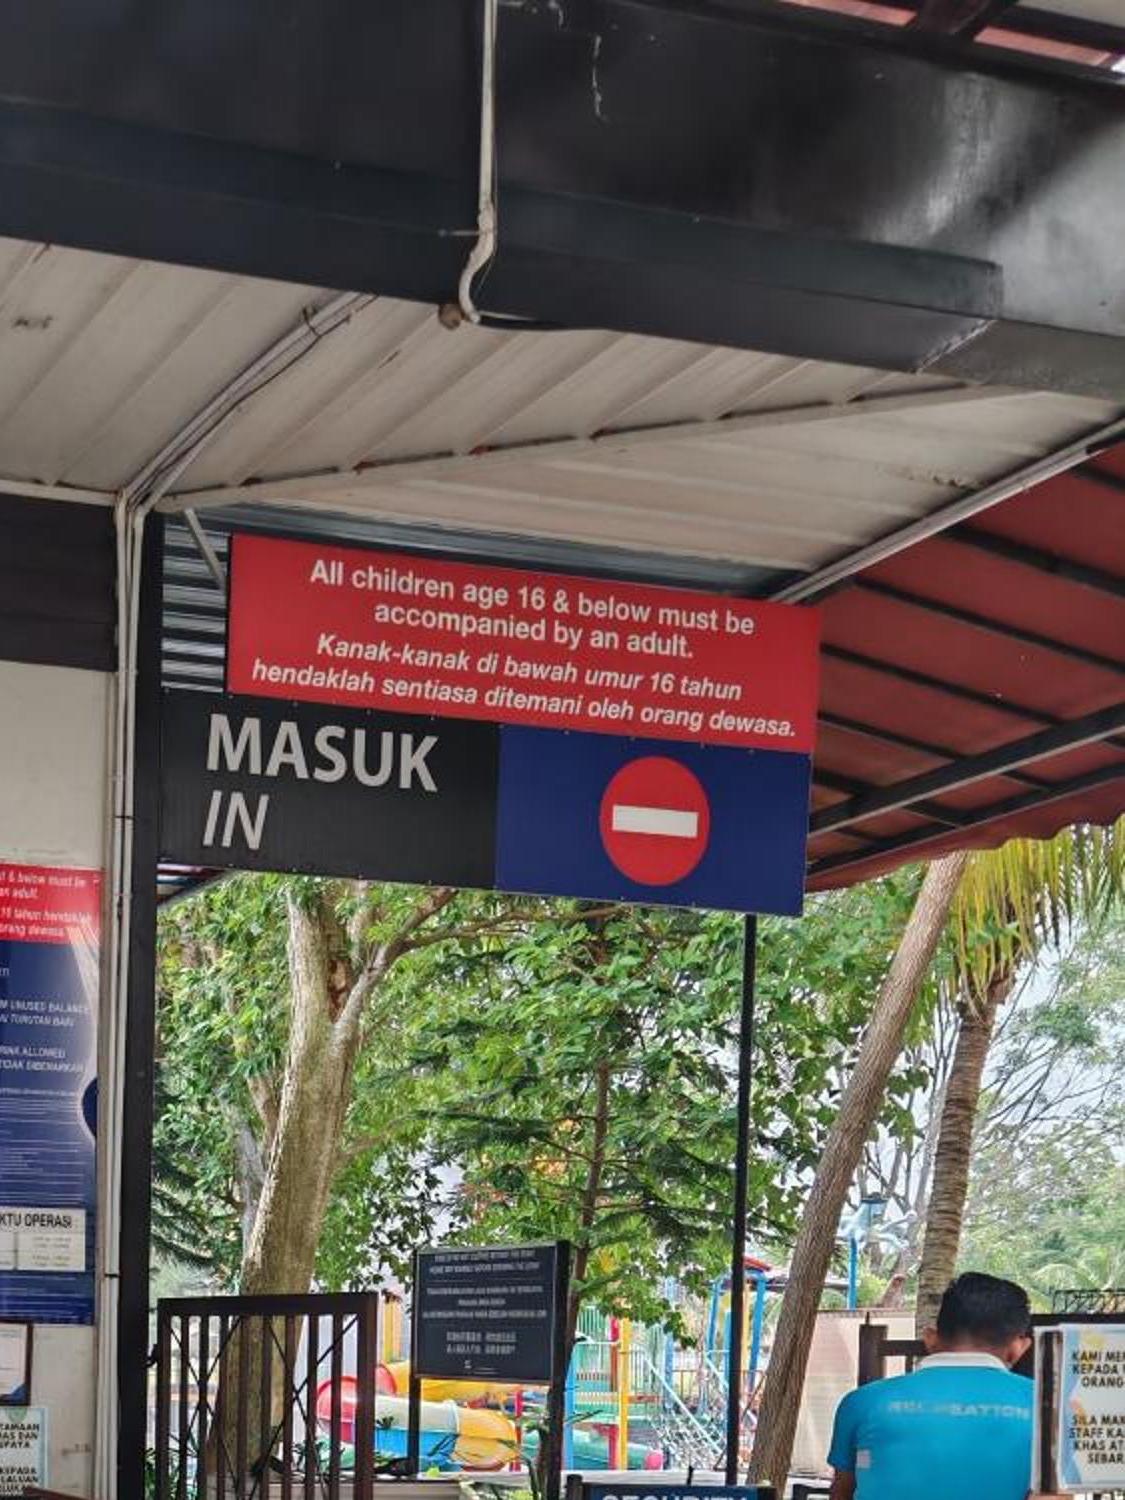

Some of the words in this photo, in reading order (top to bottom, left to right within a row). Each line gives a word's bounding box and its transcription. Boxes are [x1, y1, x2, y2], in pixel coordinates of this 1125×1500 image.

[310, 559, 344, 586] All
[352, 566, 454, 599] children
[463, 583, 508, 610] age
[519, 586, 545, 610] 16
[554, 590, 570, 613] &
[579, 592, 651, 623] below
[658, 606, 718, 631] must
[726, 610, 755, 635] be
[375, 602, 546, 641] accompanied
[554, 619, 581, 649] by
[590, 630, 619, 649] an
[627, 633, 693, 658] adult.
[317, 633, 469, 671] Kanak-kanak
[477, 654, 498, 674] di
[504, 655, 577, 683] bawah
[584, 665, 643, 689] umur
[650, 672, 675, 694] 16
[680, 674, 741, 701] tahun
[252, 659, 375, 693] hendaklah
[382, 677, 477, 704] sentiasa
[484, 687, 581, 714] ditemani
[588, 699, 634, 720] oleh
[641, 708, 701, 731] orang
[709, 710, 795, 737] dewasa.
[207, 713, 439, 793] MASUK
[202, 790, 270, 850] IN
[25, 1214, 71, 1228] OPERASI
[1073, 1351, 1101, 1360] KAMI
[1073, 1364, 1118, 1374] KEPADA
[1069, 1428, 1103, 1438] STAFF
[1074, 1441, 1105, 1450] KHAS
